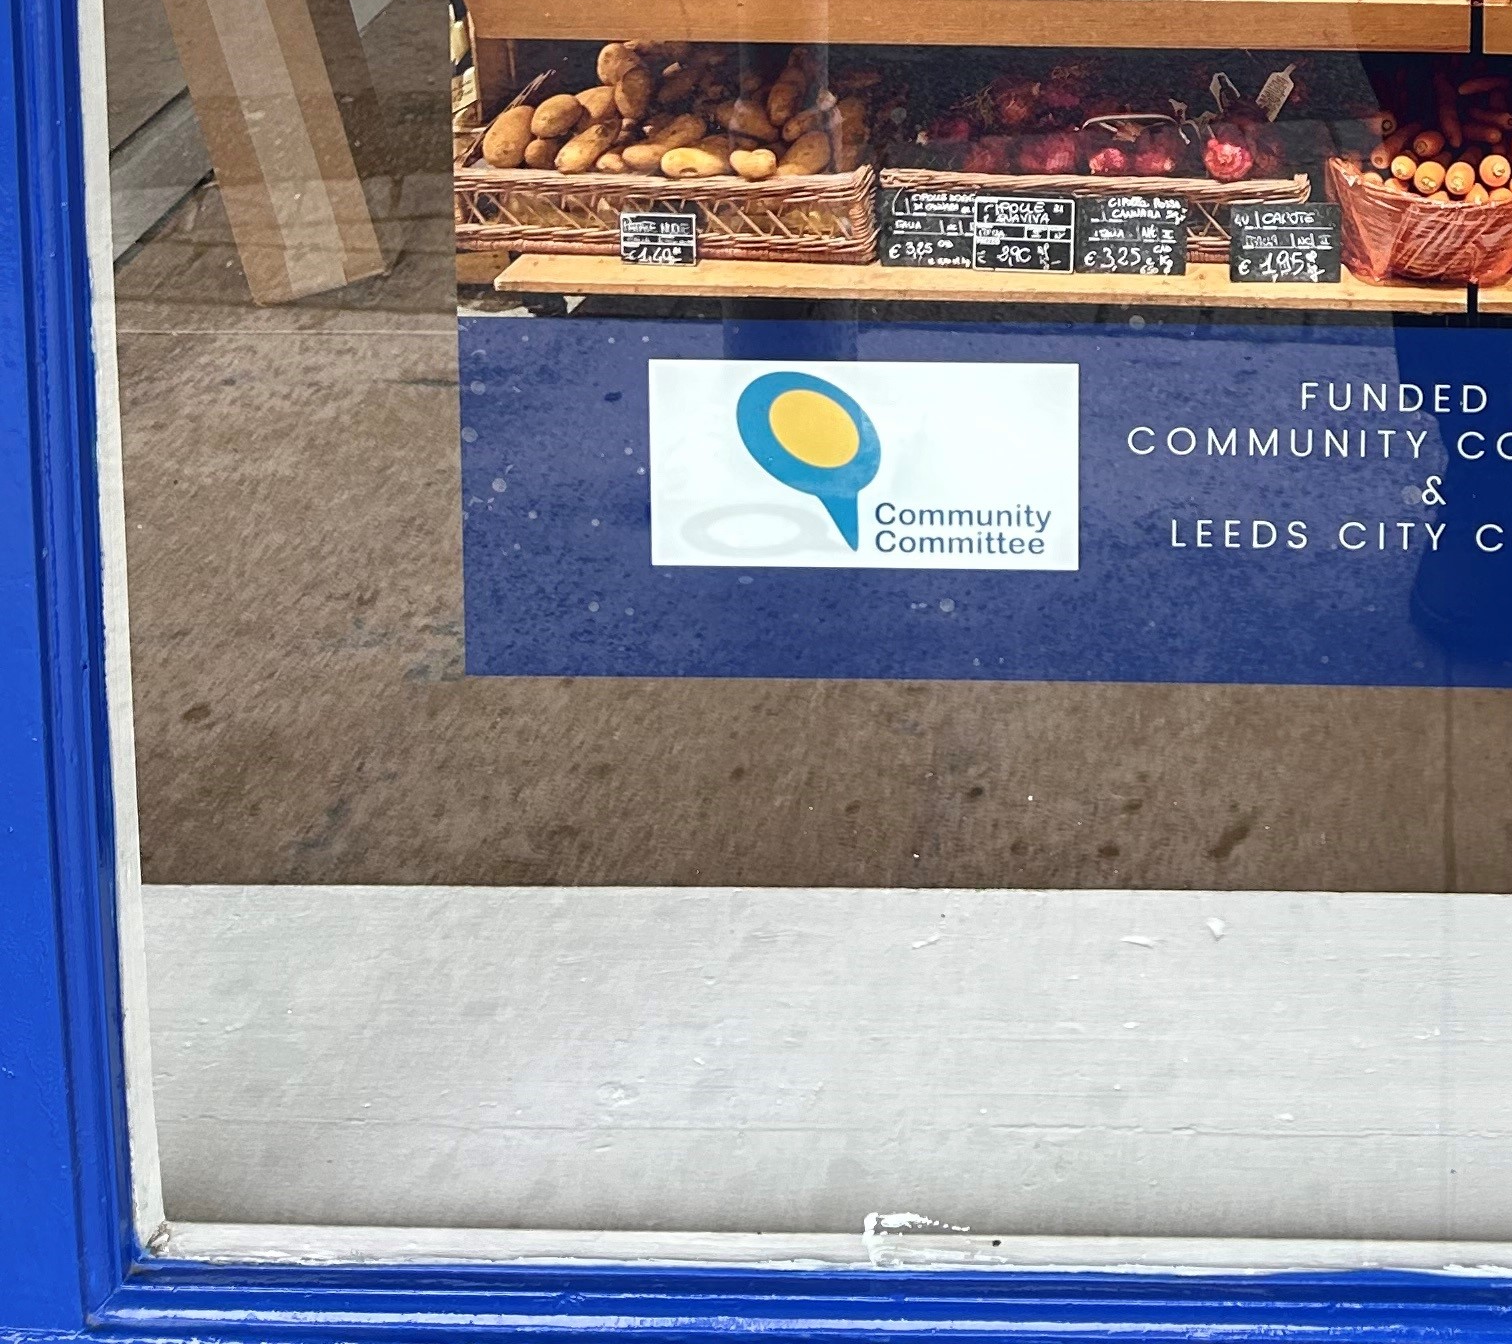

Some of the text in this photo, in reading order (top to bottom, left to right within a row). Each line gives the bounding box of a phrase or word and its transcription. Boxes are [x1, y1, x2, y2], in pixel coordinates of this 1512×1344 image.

[1083, 250, 1097, 267] €
[1238, 258, 1252, 276] €
[1300, 381, 1488, 415] FUNDED
[1127, 425, 1429, 461] COMMUNITY
[1420, 475, 1448, 507] &
[875, 502, 1052, 533] Community
[875, 529, 1046, 555] Committee
[1171, 517, 1310, 550] LEEDS
[1338, 520, 1448, 552] CITY
